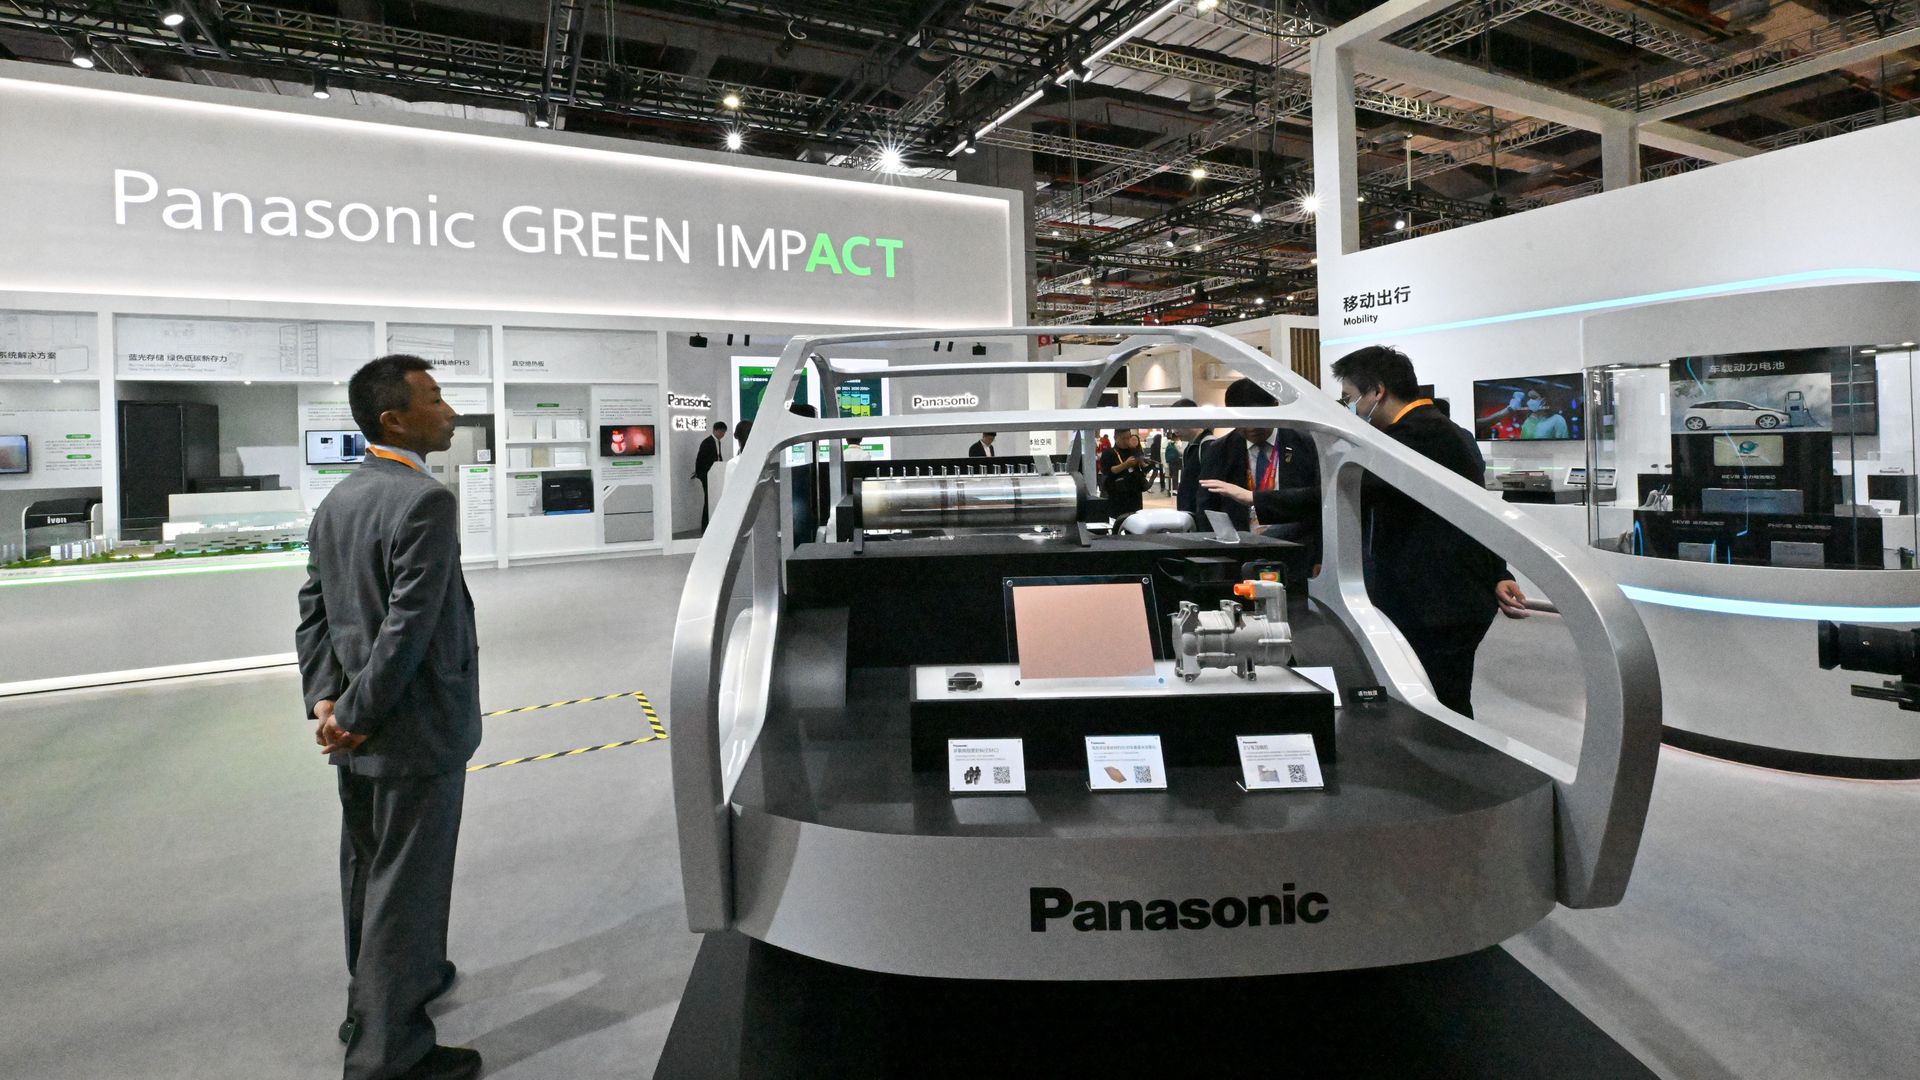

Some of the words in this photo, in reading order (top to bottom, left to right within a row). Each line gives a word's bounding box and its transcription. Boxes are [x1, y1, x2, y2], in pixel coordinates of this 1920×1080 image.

[114, 168, 476, 249] Panasonic
[502, 205, 690, 264] GREEN
[716, 223, 904, 278] IMPACT
[1343, 286, 1411, 312] 移动出行
[1343, 314, 1378, 326] Mobility
[1709, 361, 1786, 373] 车载动力电池
[668, 393, 712, 408] Panasonic
[913, 395, 977, 407] Panasonic
[1029, 883, 1330, 932] Panasonic
